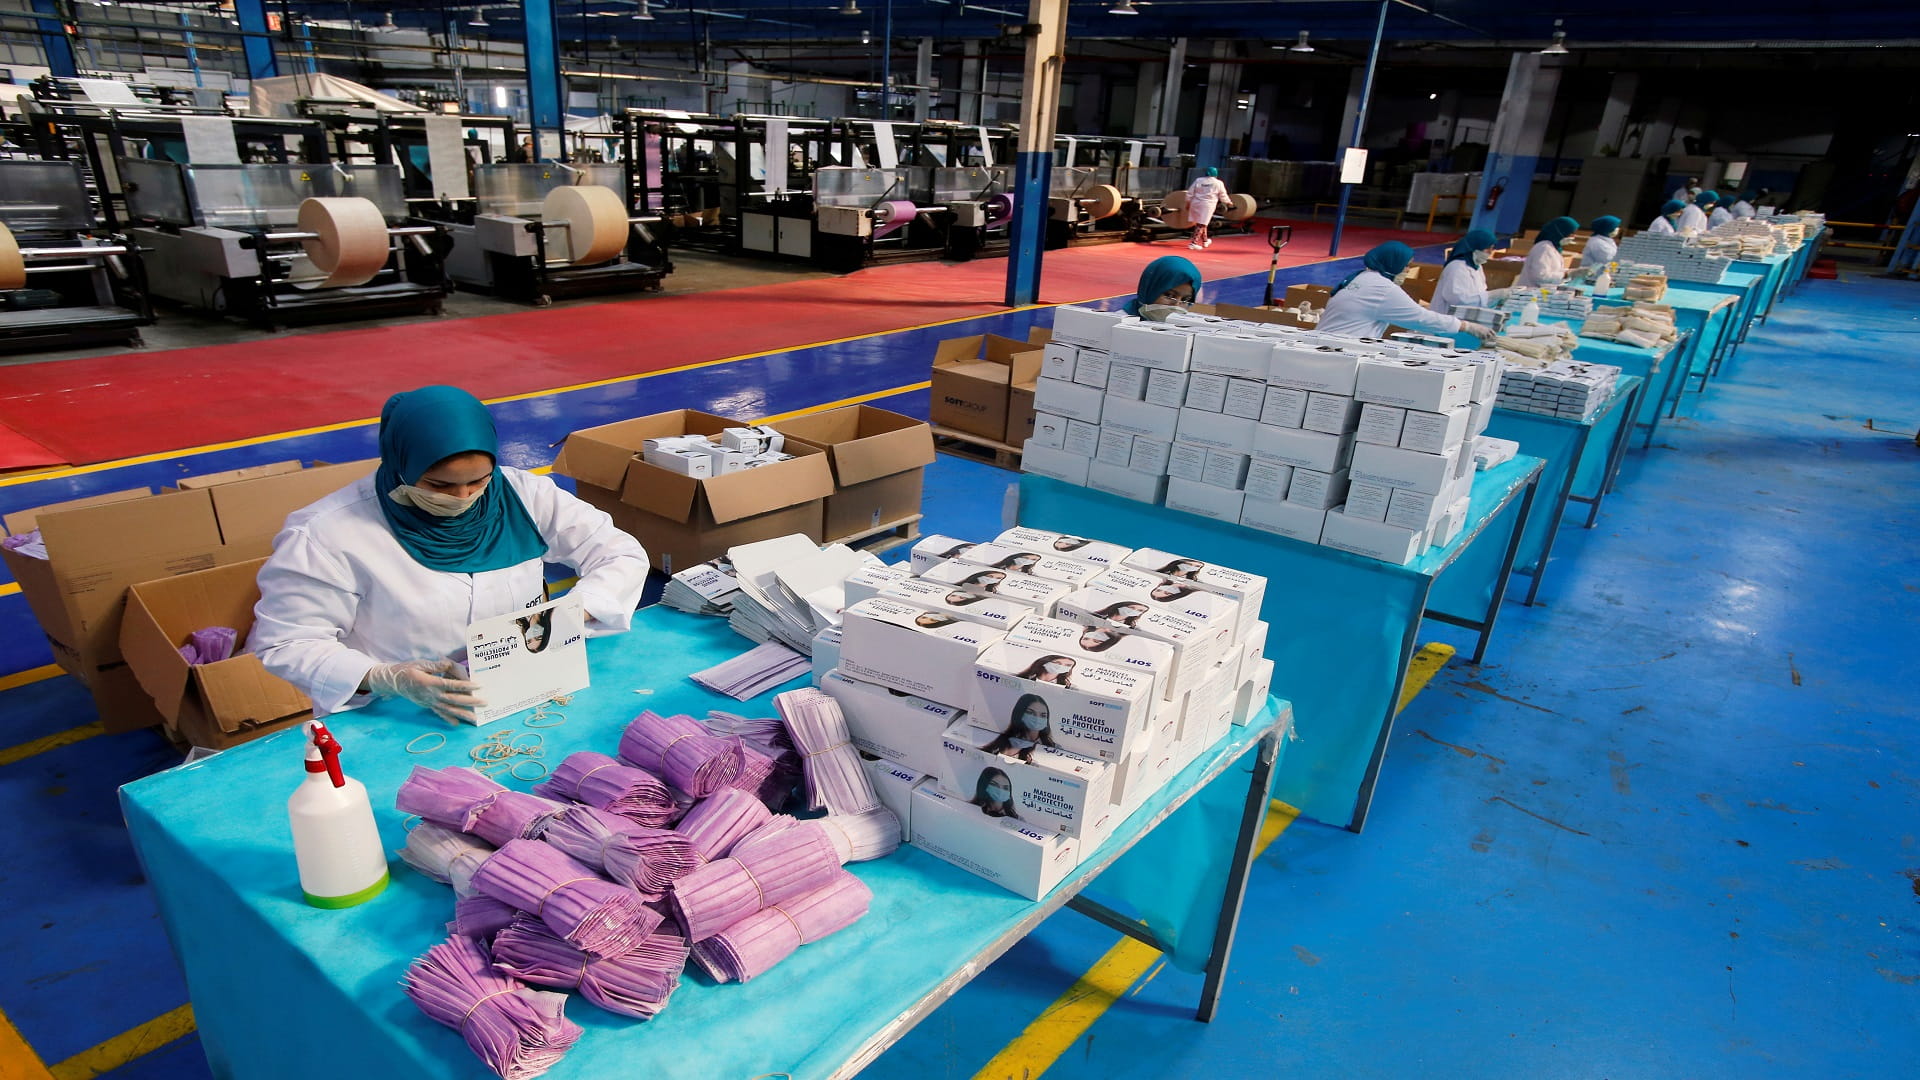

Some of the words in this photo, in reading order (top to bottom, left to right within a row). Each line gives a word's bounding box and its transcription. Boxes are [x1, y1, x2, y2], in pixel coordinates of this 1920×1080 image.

[484, 651, 510, 662] MASQUES
[1061, 717, 1070, 725] DE
[1072, 720, 1115, 735] PROTECTION
[1072, 713, 1105, 726] MASQUES
[1023, 791, 1031, 799] DE
[1033, 794, 1074, 811] PROTECTION
[1033, 788, 1064, 802] MASQUES
